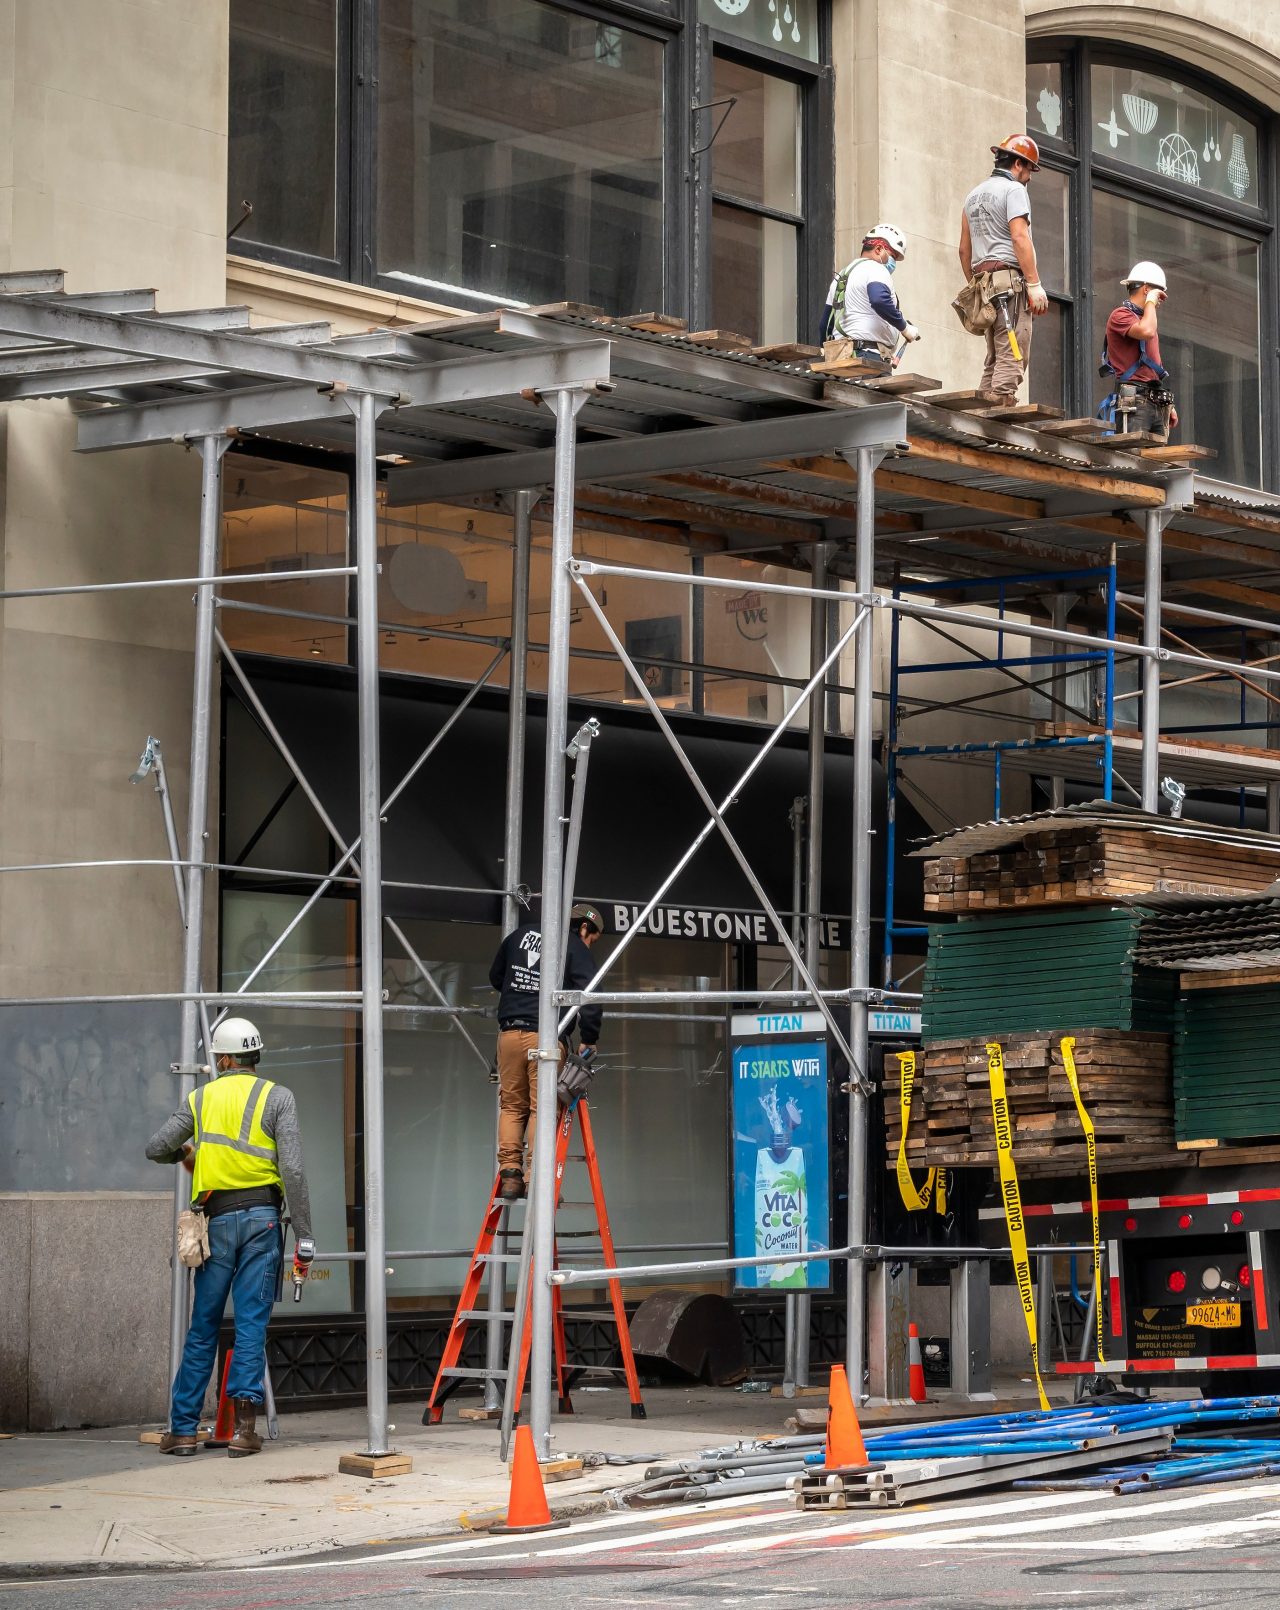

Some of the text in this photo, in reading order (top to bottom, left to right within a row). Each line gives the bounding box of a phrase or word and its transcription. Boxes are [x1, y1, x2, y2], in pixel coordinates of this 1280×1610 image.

[614, 904, 768, 942] BLUESTONE
[757, 1015, 803, 1032] TITAN
[873, 1014, 912, 1031] TITAN
[739, 1061, 749, 1079] IT
[750, 1059, 791, 1079] STARTS
[994, 1097, 1010, 1150] CAUTION
[1086, 1132, 1097, 1185] CAUTION
[763, 1191, 797, 1211] VITA
[1003, 1180, 1023, 1232] CAUTION
[762, 1212, 801, 1228] COCO
[764, 1225, 799, 1250] Coconut
[1015, 1260, 1033, 1313] CAUTION
[1192, 1306, 1220, 1322] 99624
